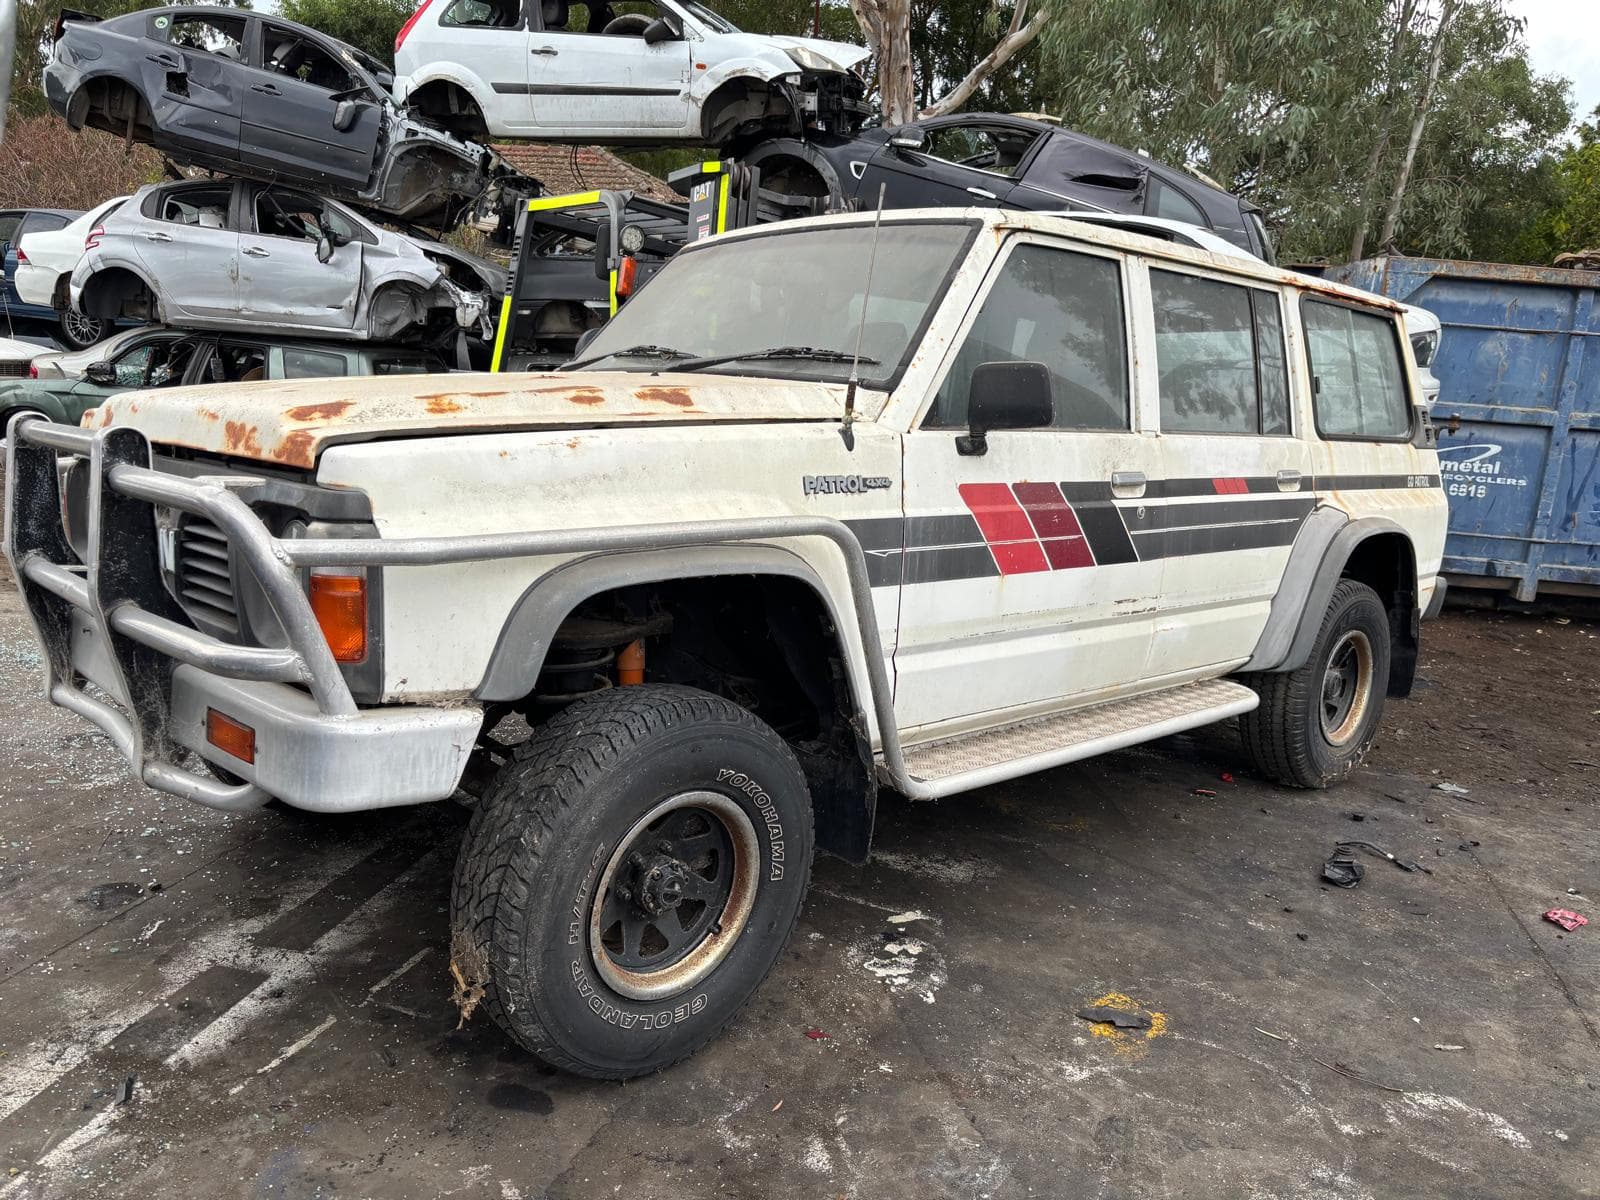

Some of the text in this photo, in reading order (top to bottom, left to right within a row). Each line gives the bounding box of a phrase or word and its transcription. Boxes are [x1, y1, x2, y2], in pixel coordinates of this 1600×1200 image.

[694, 181, 711, 202] CAT
[1440, 460, 1501, 474] metal
[803, 474, 867, 496] PATROL
[716, 768, 785, 881] YOKOHAMA
[571, 960, 708, 1030] GEOLANDAR
